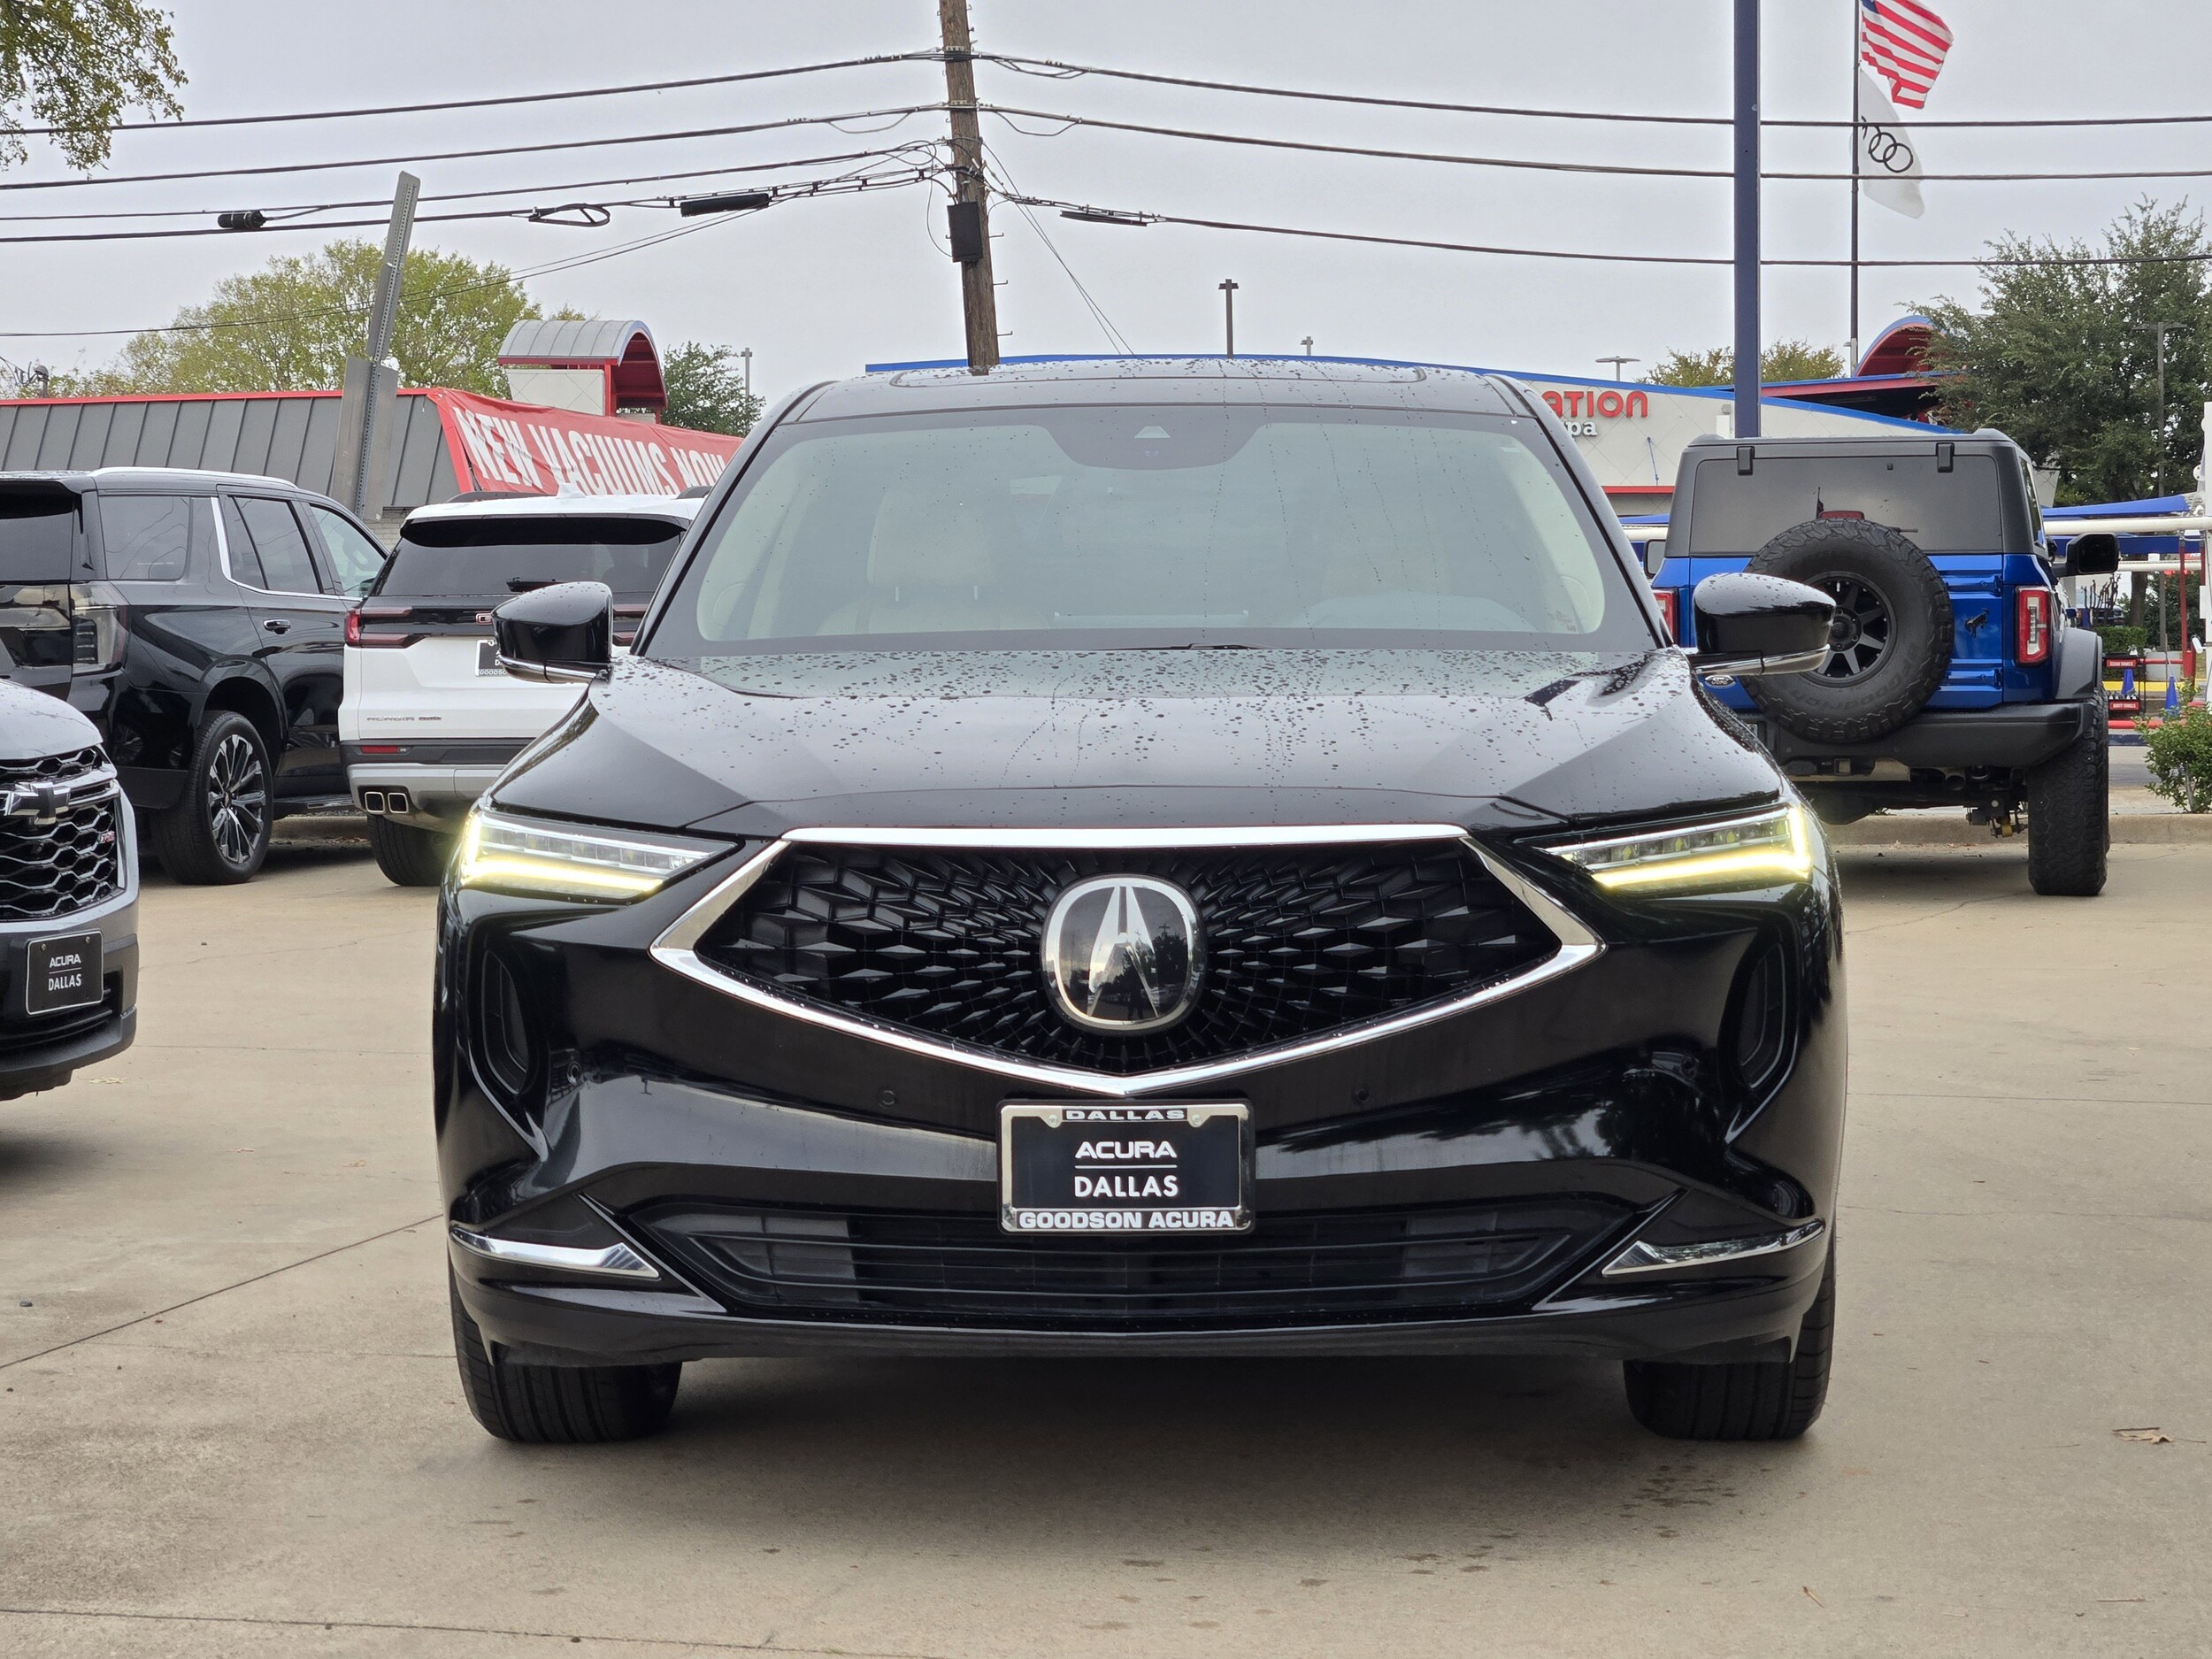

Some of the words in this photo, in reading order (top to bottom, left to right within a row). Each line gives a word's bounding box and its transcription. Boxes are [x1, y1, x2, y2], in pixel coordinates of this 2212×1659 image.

[1561, 420, 1599, 436] pa
[452, 406, 543, 489] NEW
[526, 423, 680, 495] VACUUMS
[49, 953, 81, 968] ACURA
[48, 973, 82, 991] DALLAS
[1065, 1110, 1185, 1120] DALLAS
[1074, 1141, 1178, 1159] ACURA
[1073, 1175, 1179, 1198] DALLAS
[1018, 1211, 1142, 1229] GOODSON
[1148, 1210, 1235, 1229] ACURA
